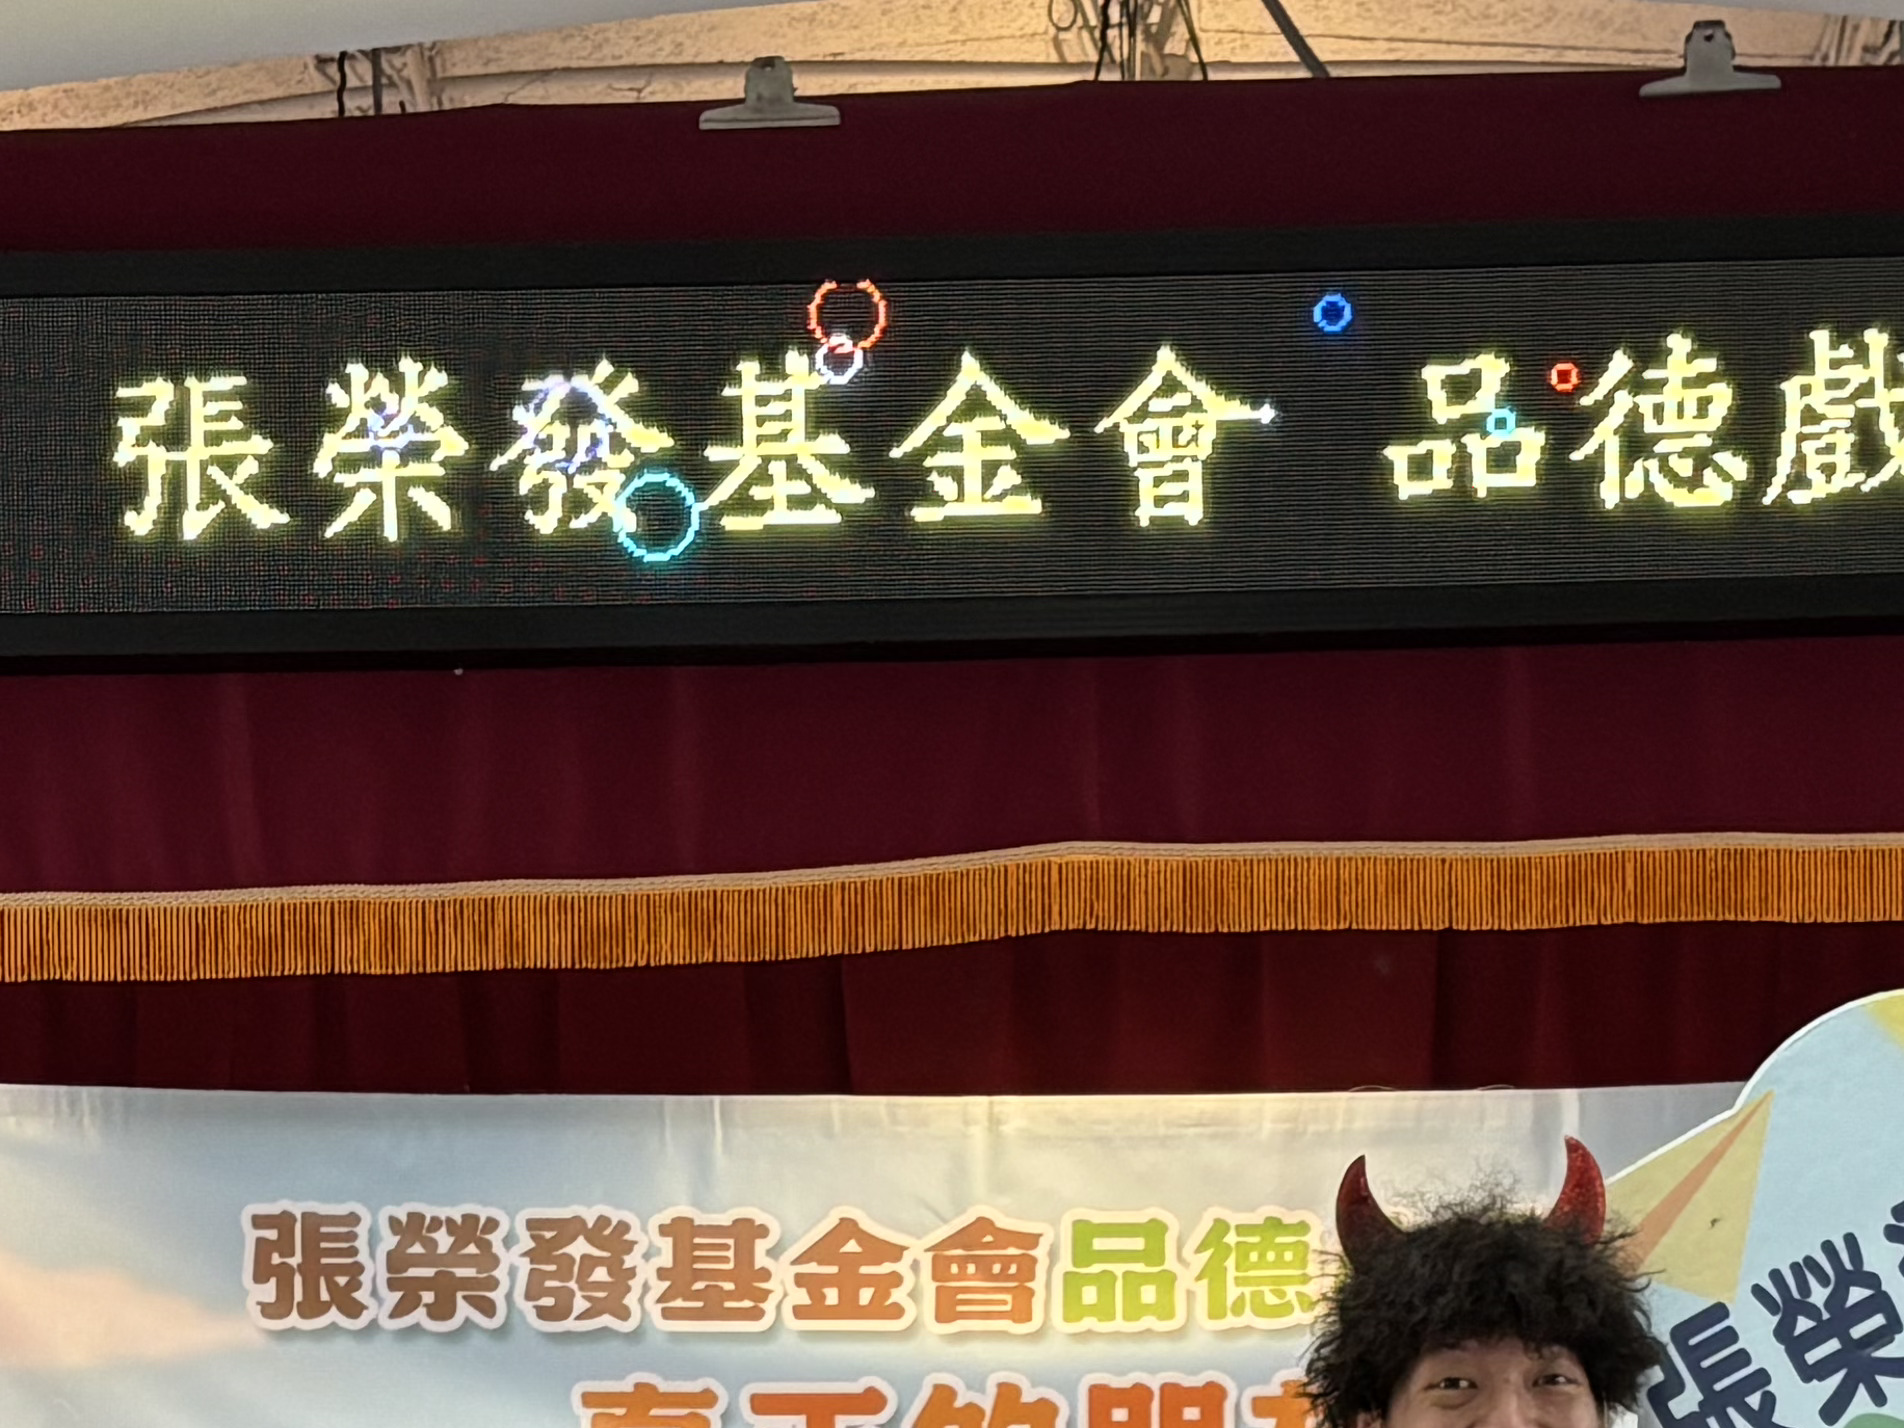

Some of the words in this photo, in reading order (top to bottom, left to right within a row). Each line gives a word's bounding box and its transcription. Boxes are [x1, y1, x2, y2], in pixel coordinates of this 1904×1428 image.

[110, 343, 1264, 542] 張榮發基金會
